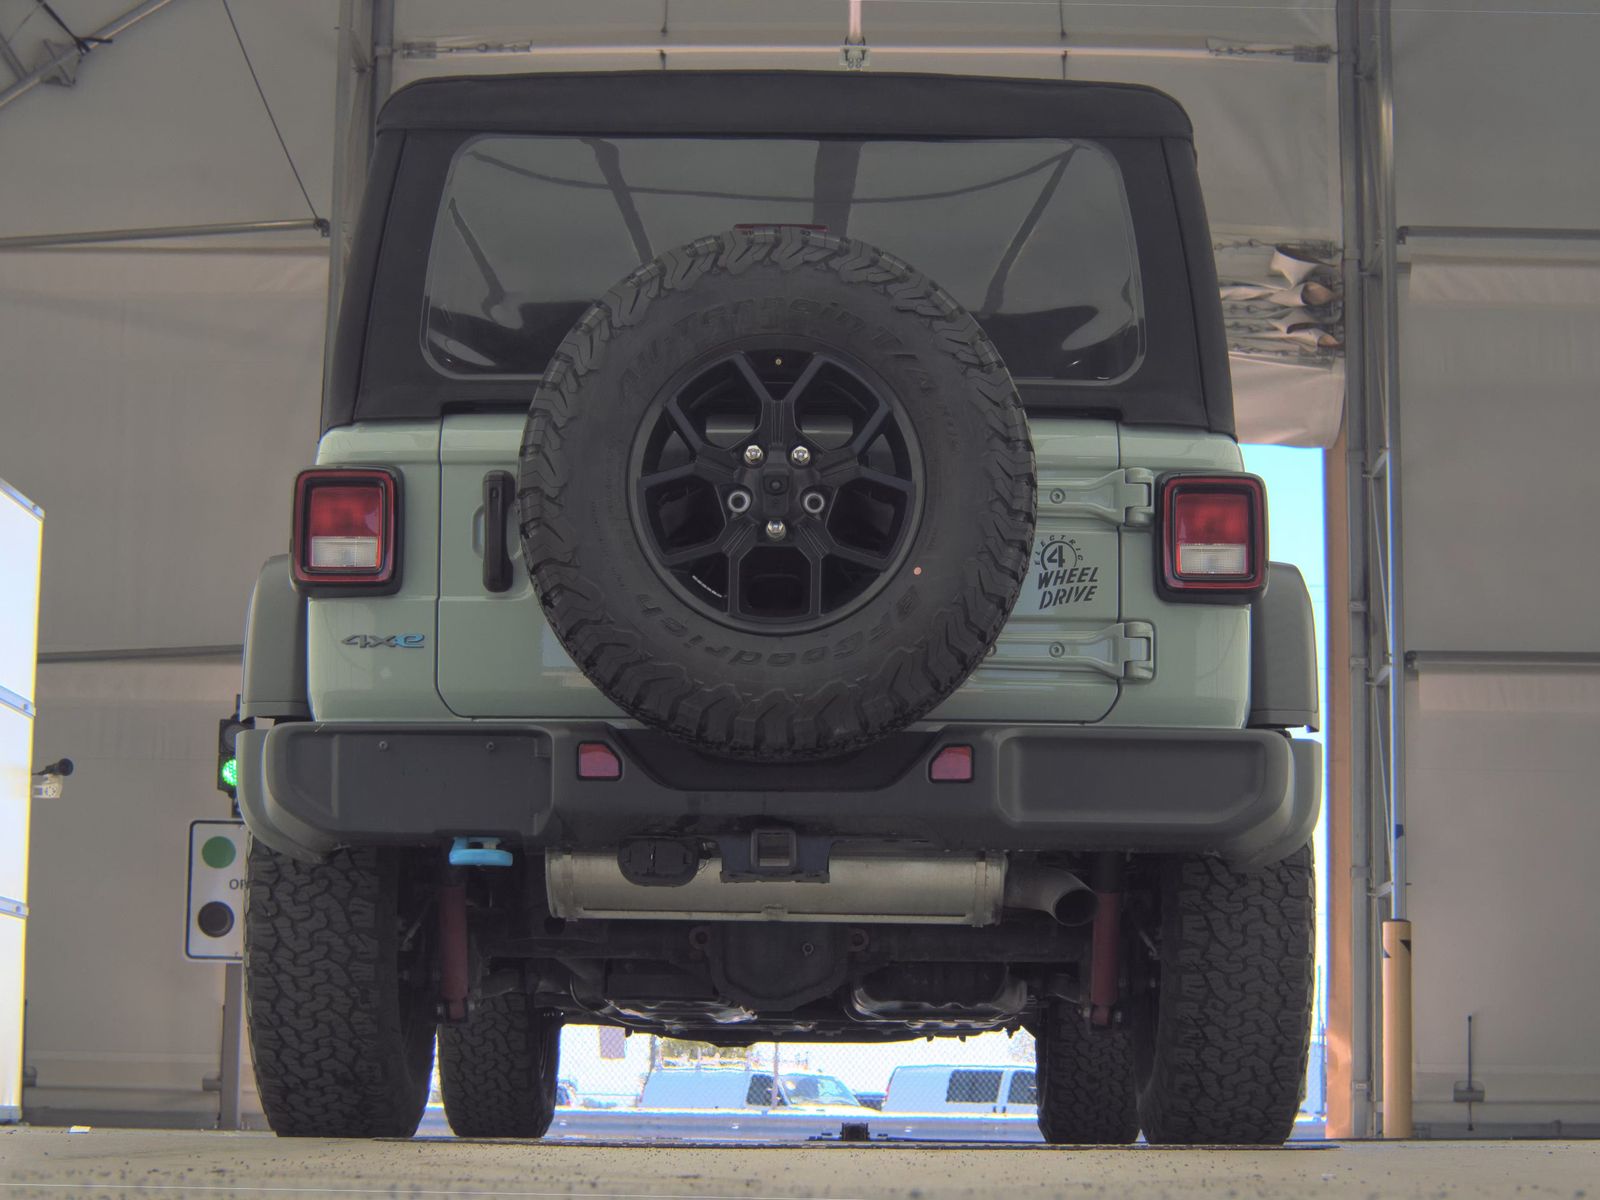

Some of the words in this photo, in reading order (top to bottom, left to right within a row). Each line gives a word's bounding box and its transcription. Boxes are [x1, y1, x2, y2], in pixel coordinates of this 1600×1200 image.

[1047, 545, 1066, 568] 4
[1038, 567, 1099, 590] WHEEL
[1039, 586, 1098, 610] DRIVE
